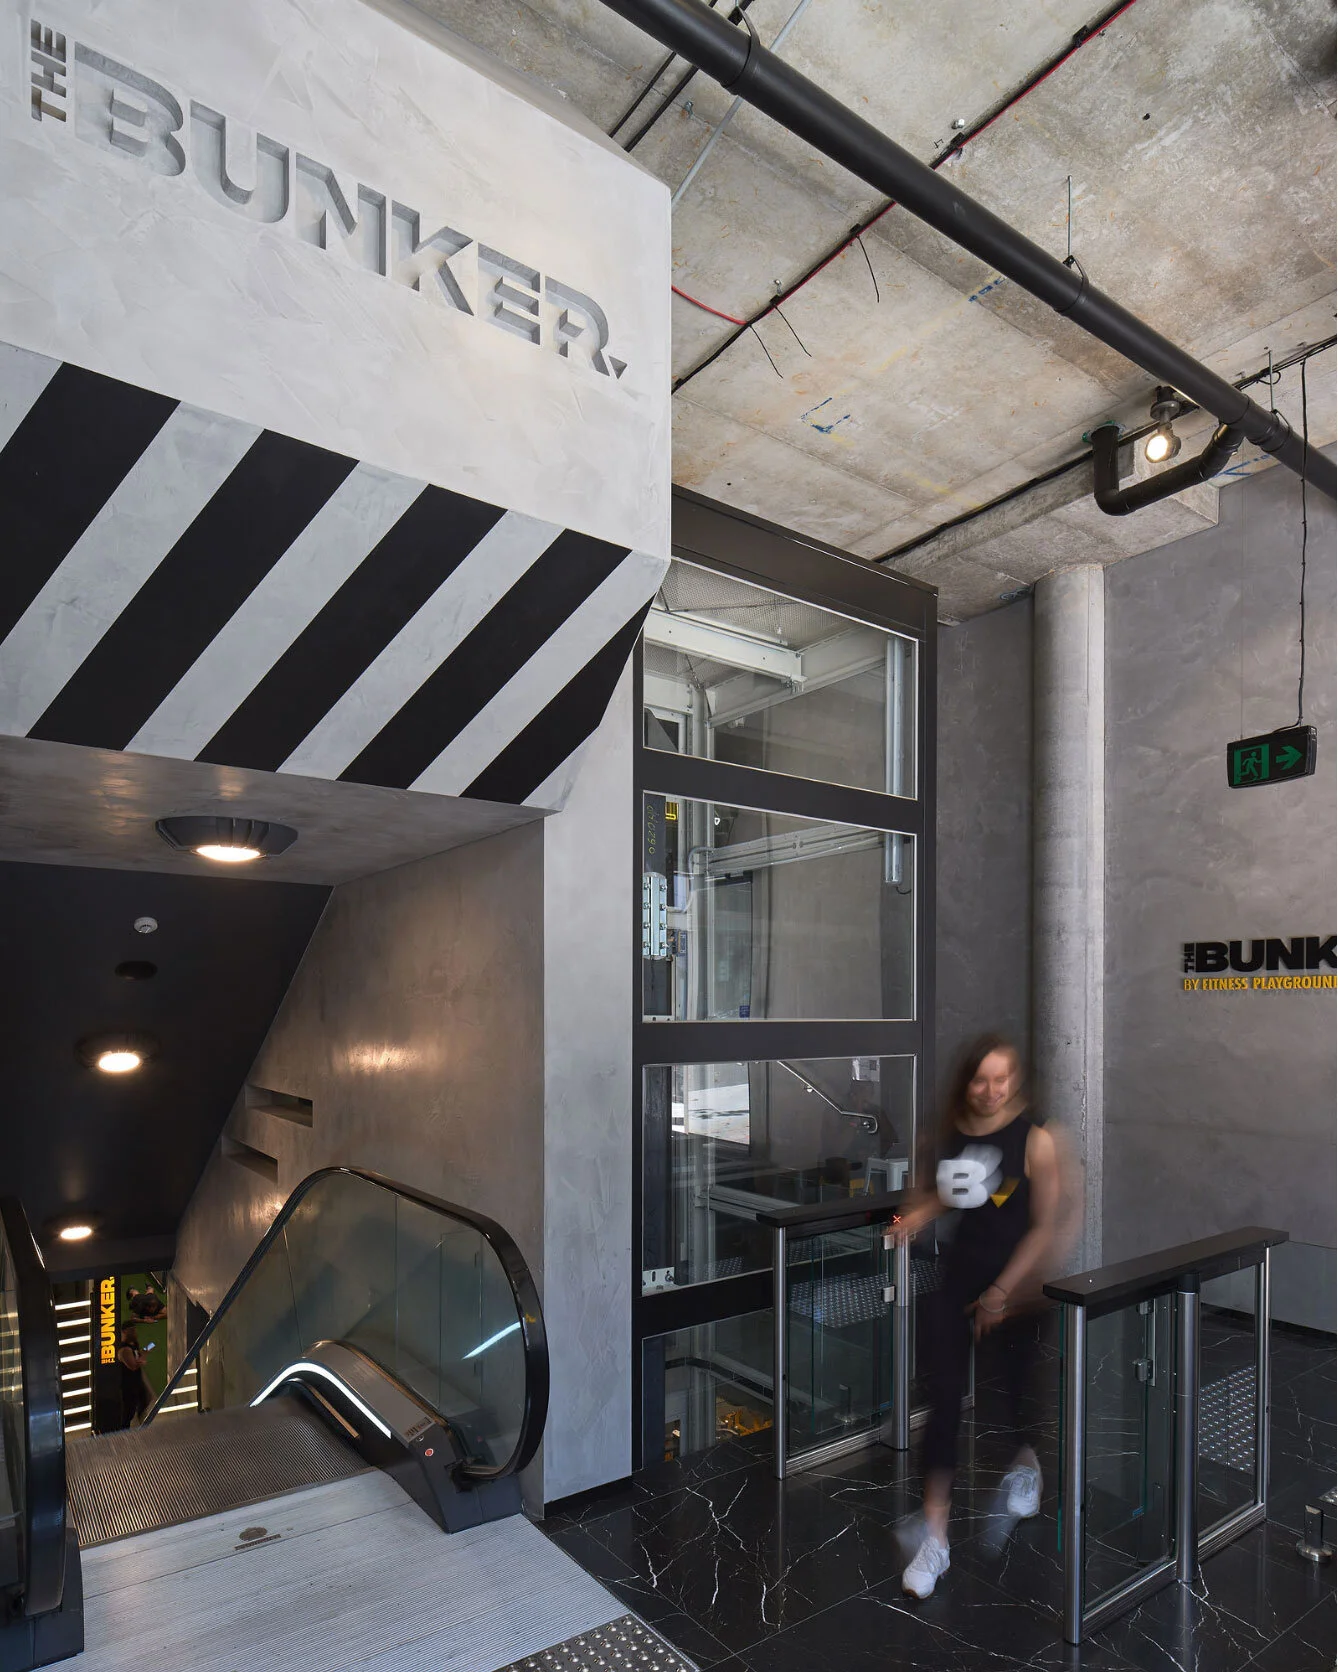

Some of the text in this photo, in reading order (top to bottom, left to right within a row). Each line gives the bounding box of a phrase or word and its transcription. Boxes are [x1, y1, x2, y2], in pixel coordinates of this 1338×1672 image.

[31, 18, 628, 379] THE BUNKER
[1183, 943, 1195, 973] THE
[1184, 979, 1199, 991] BY
[1202, 977, 1249, 991] FITNESS
[936, 1158, 989, 1209] B
[101, 1276, 116, 1358] BUNKER
